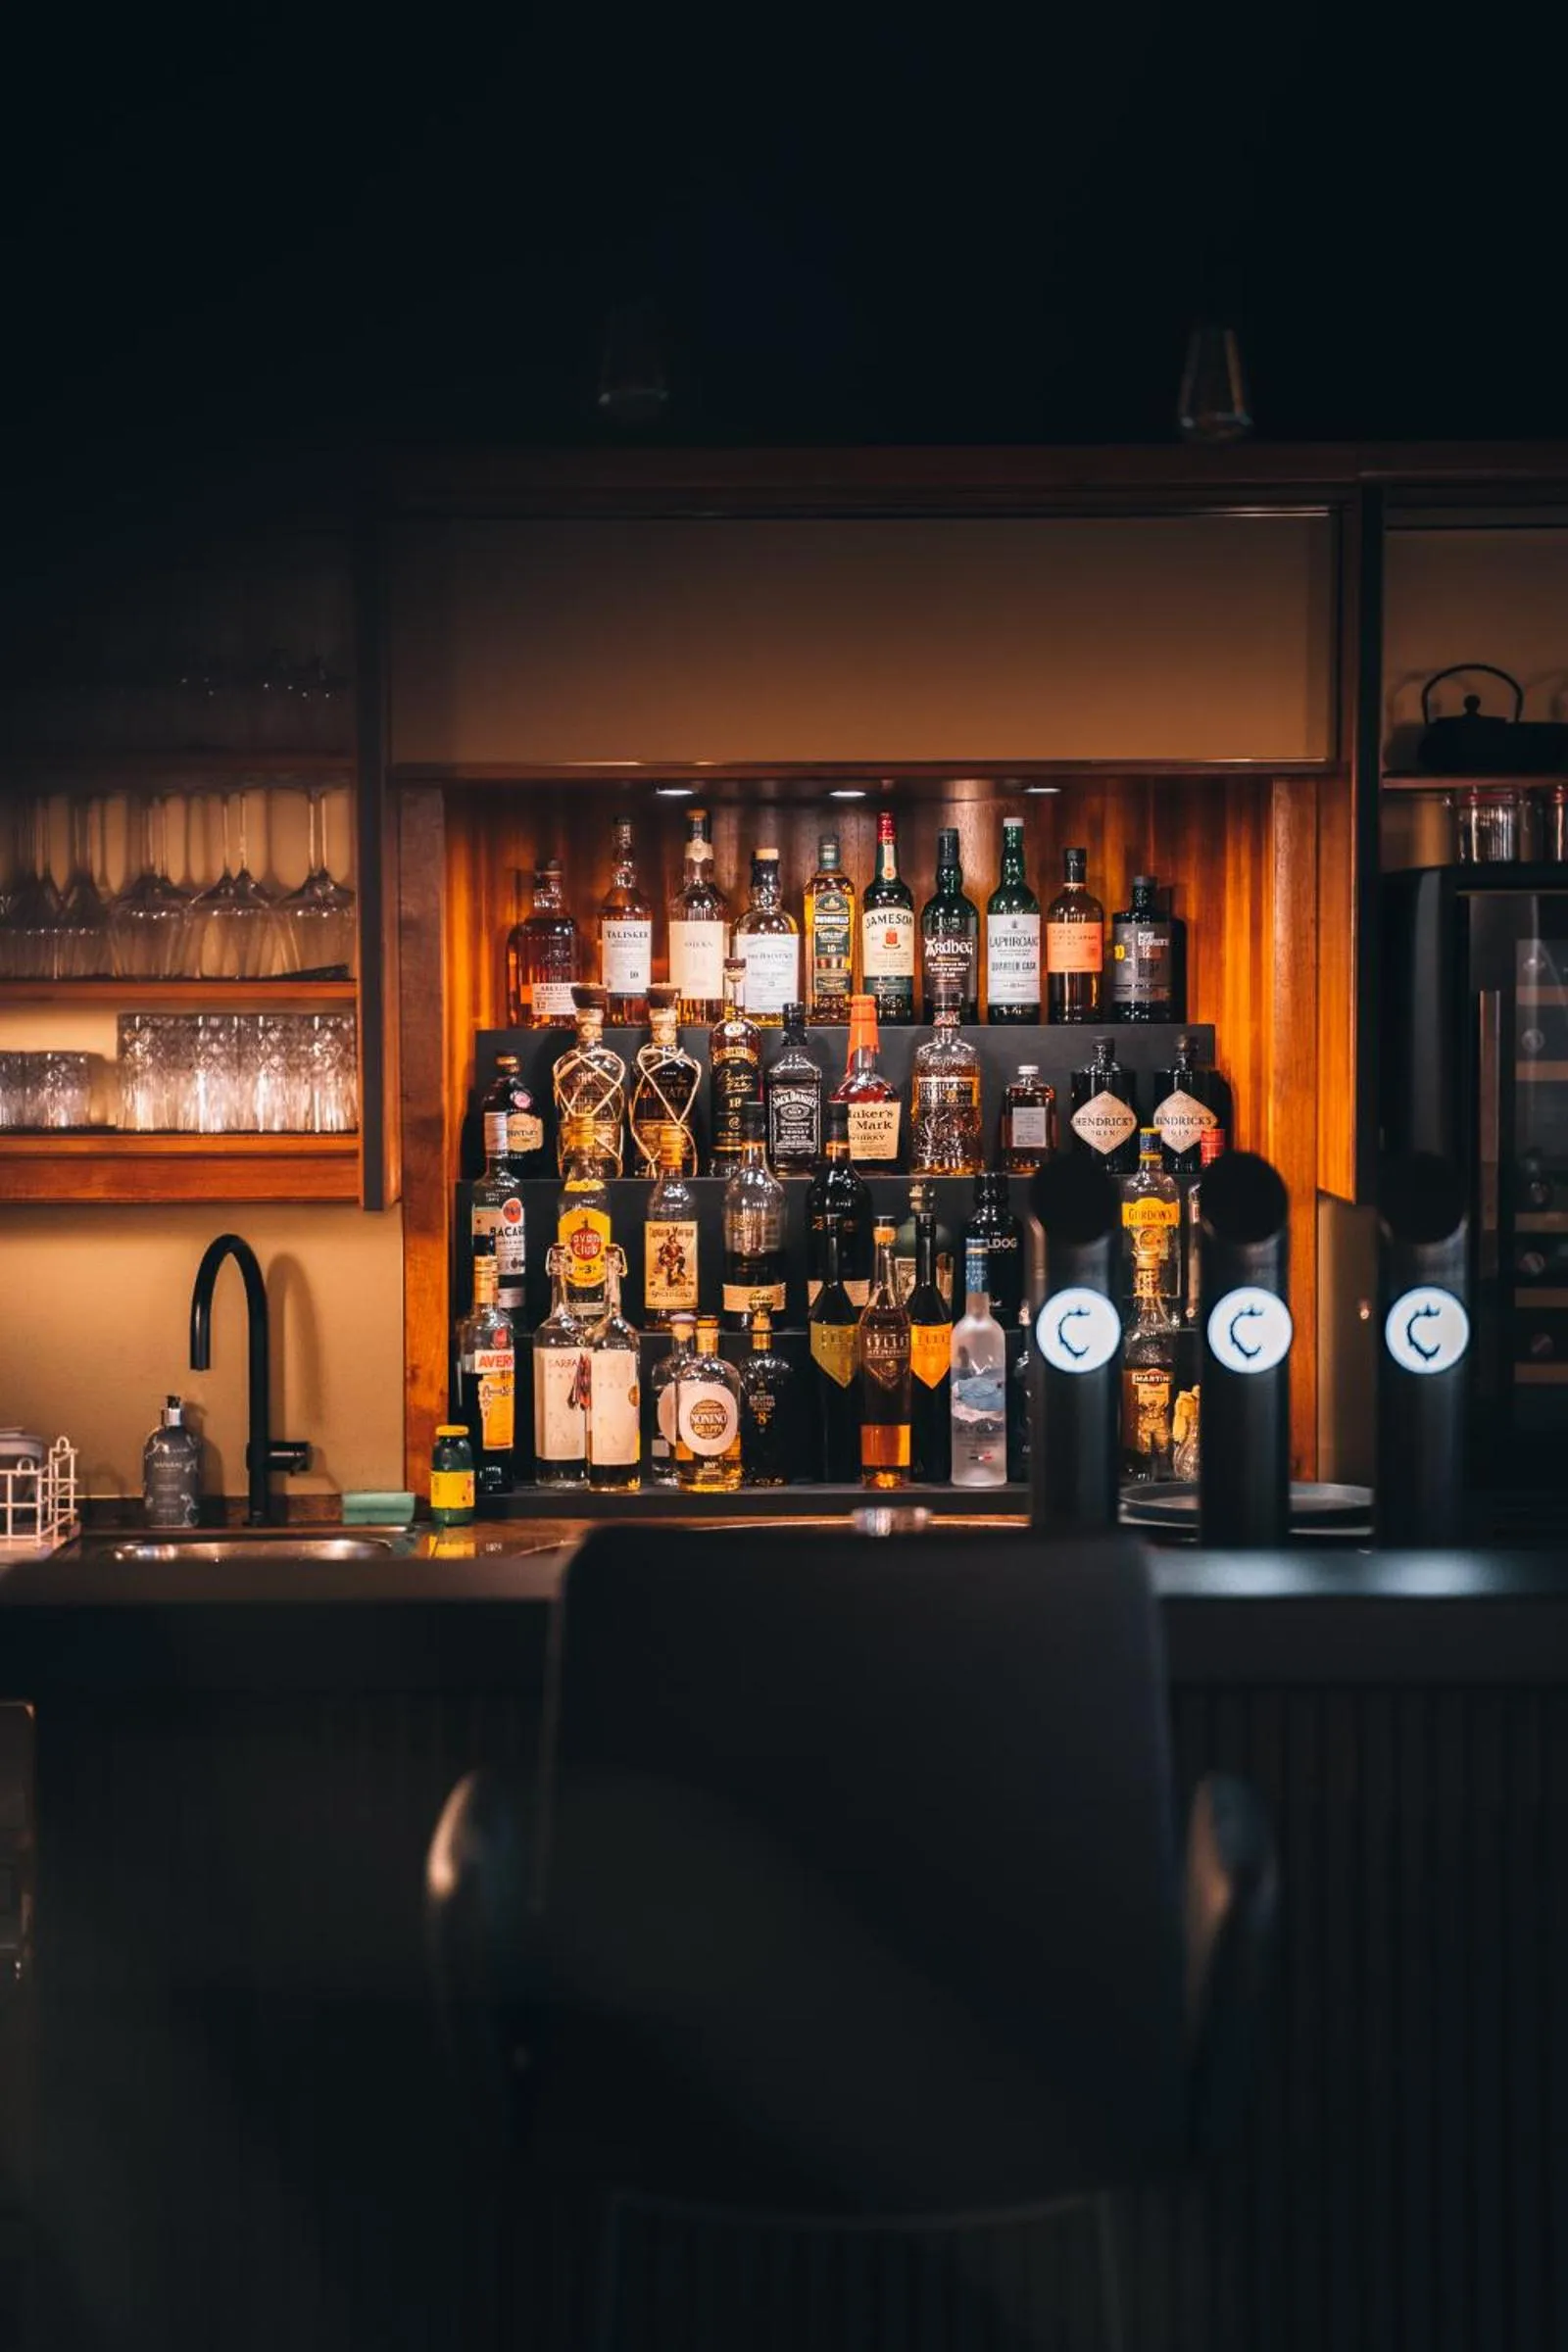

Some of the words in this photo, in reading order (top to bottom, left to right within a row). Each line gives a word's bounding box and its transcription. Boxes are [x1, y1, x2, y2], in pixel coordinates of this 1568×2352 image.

[848, 1109, 894, 1118] aker's
[856, 1120, 894, 1130] Mark
[987, 1238, 1017, 1250] LDOG
